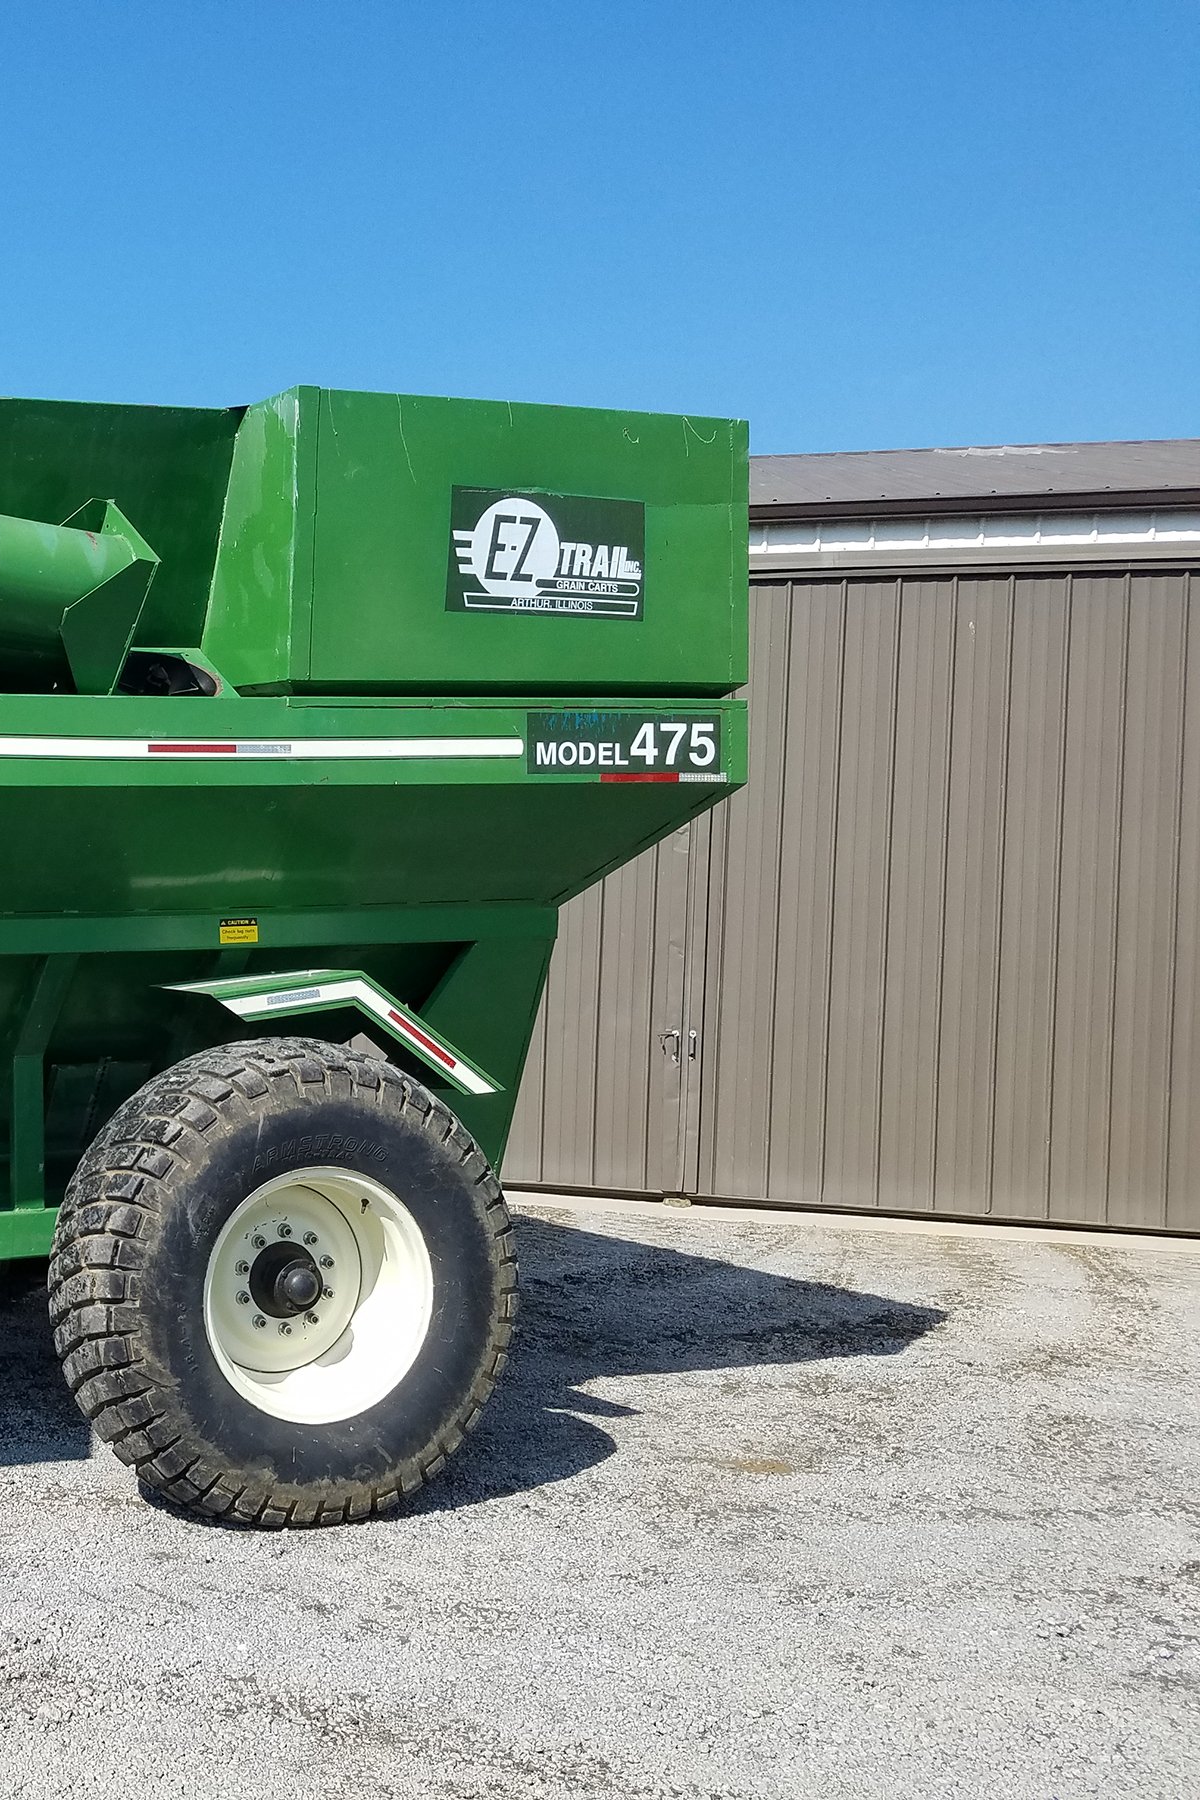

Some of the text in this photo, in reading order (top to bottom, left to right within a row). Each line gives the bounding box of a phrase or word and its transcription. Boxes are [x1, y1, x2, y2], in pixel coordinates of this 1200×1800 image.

[560, 541, 642, 580] TRAIL
[555, 599, 594, 611] ILLINOIS
[556, 580, 619, 593] GRAIN CARTS
[536, 722, 716, 767] MODEL 475
[251, 1133, 390, 1175] ARMSTRONG
